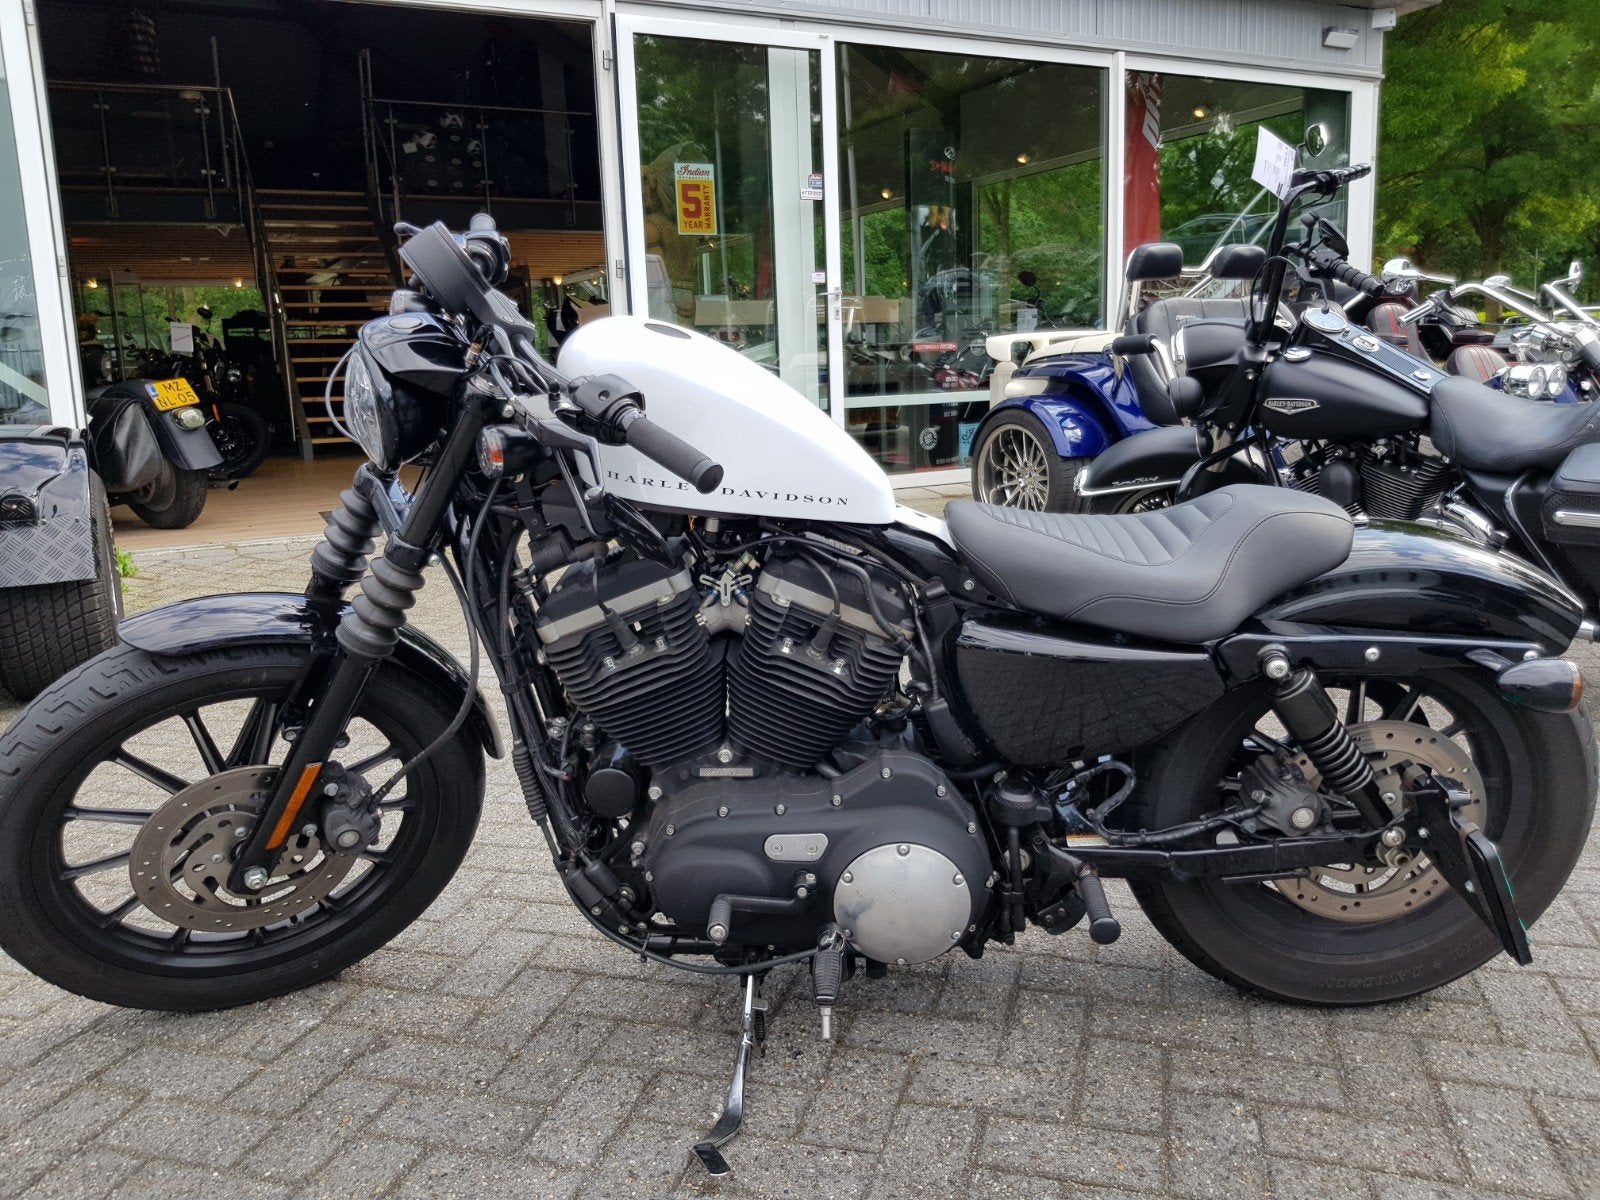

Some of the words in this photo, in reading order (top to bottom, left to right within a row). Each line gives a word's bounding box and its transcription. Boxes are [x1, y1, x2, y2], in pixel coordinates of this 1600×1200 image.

[677, 164, 711, 177] Indian
[681, 183, 702, 218] 5
[702, 184, 712, 229] WARRANTY
[683, 220, 704, 229] YEAR
[606, 470, 691, 492] HARLE
[721, 486, 850, 506] DAVIDSON
